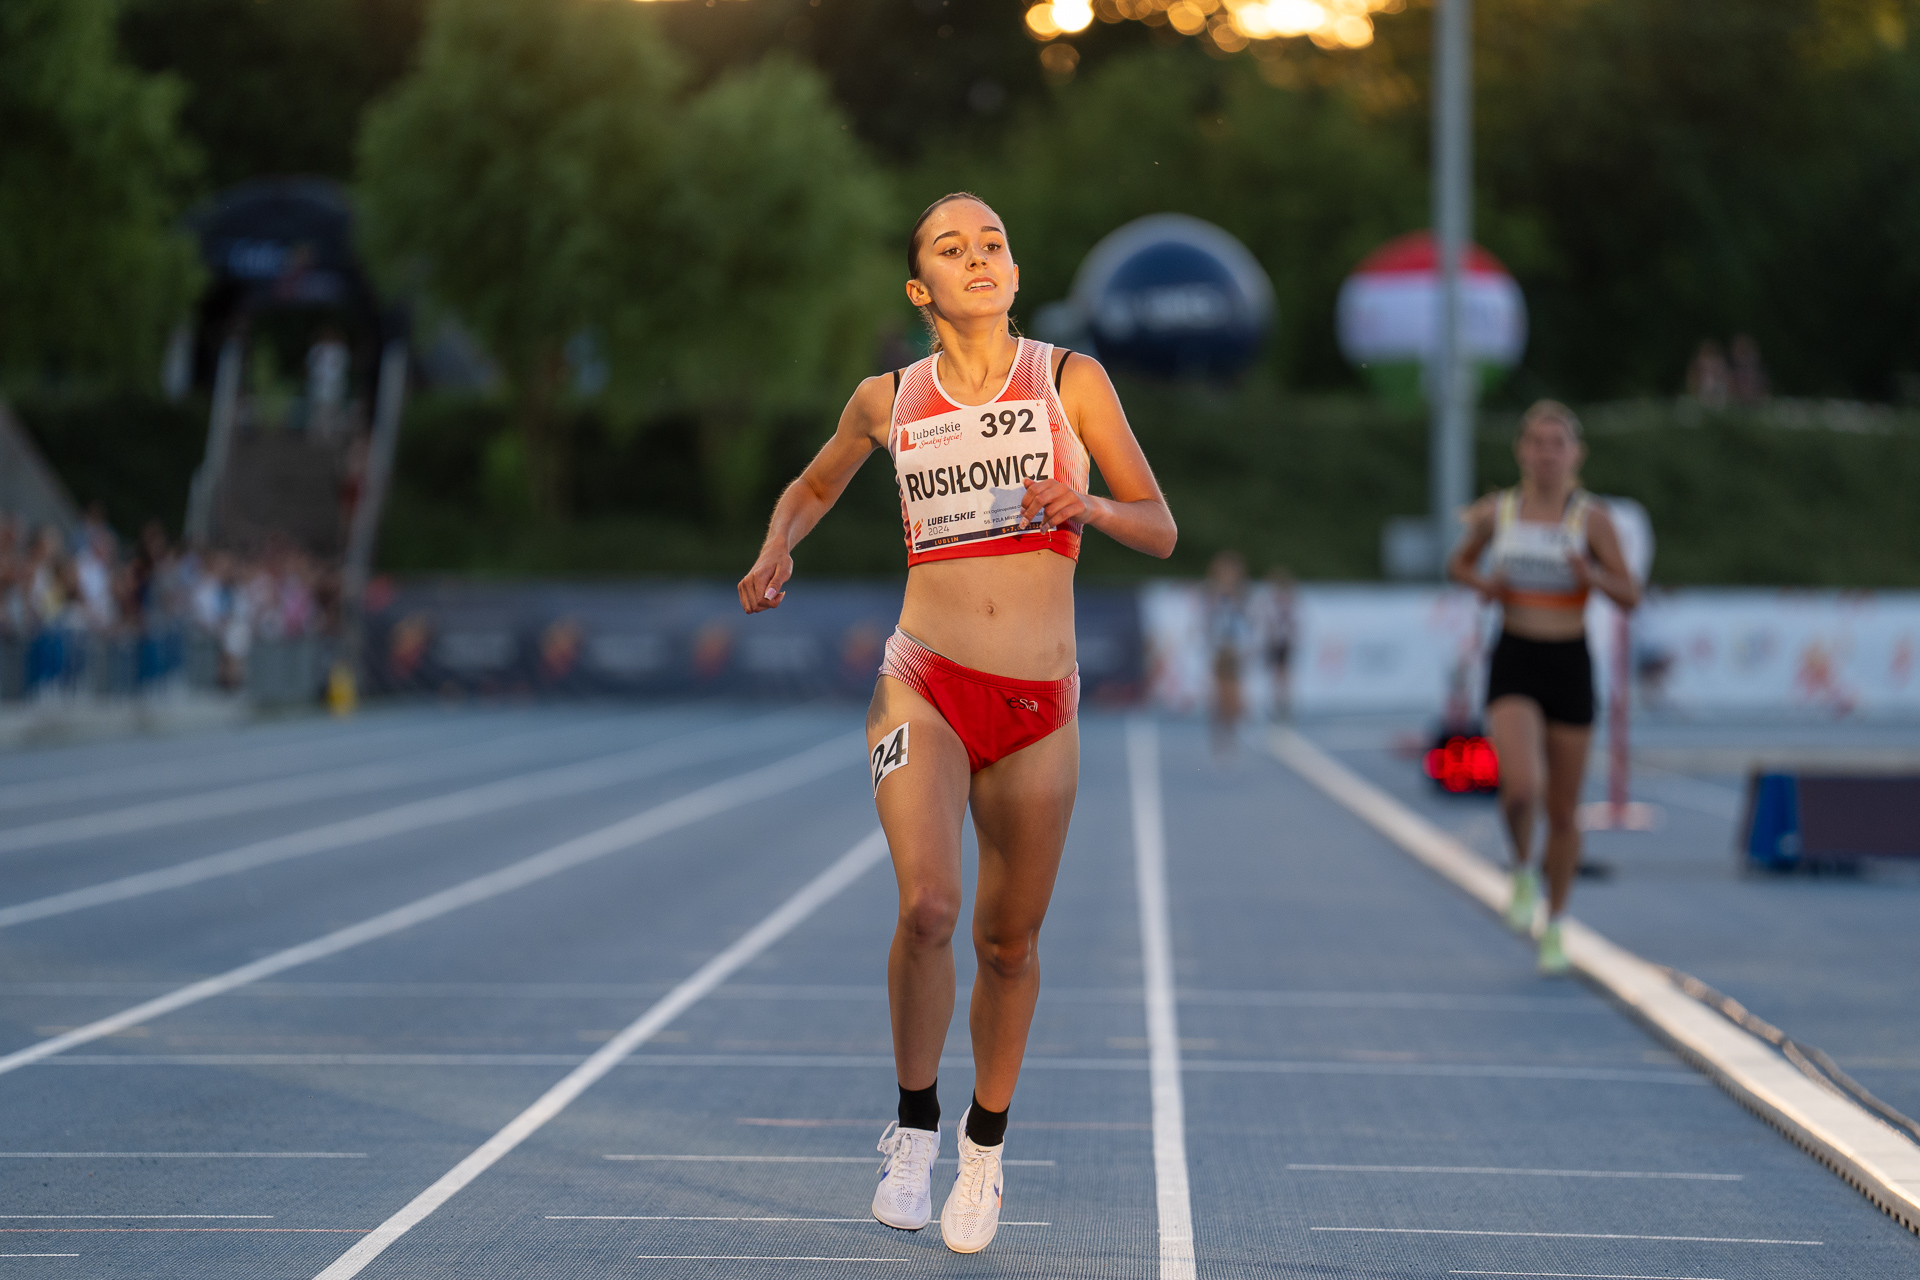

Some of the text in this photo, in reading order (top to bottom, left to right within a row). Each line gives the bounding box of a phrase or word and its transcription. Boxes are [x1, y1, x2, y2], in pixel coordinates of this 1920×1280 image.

[912, 422, 961, 441] lubelskie
[979, 408, 1037, 438] 392
[905, 452, 1049, 502] RUSIŁOWICZ
[927, 510, 977, 527] LUBELSKIE
[928, 525, 950, 536] 2024
[934, 536, 959, 546] LUBLIN
[872, 727, 907, 796] 24
